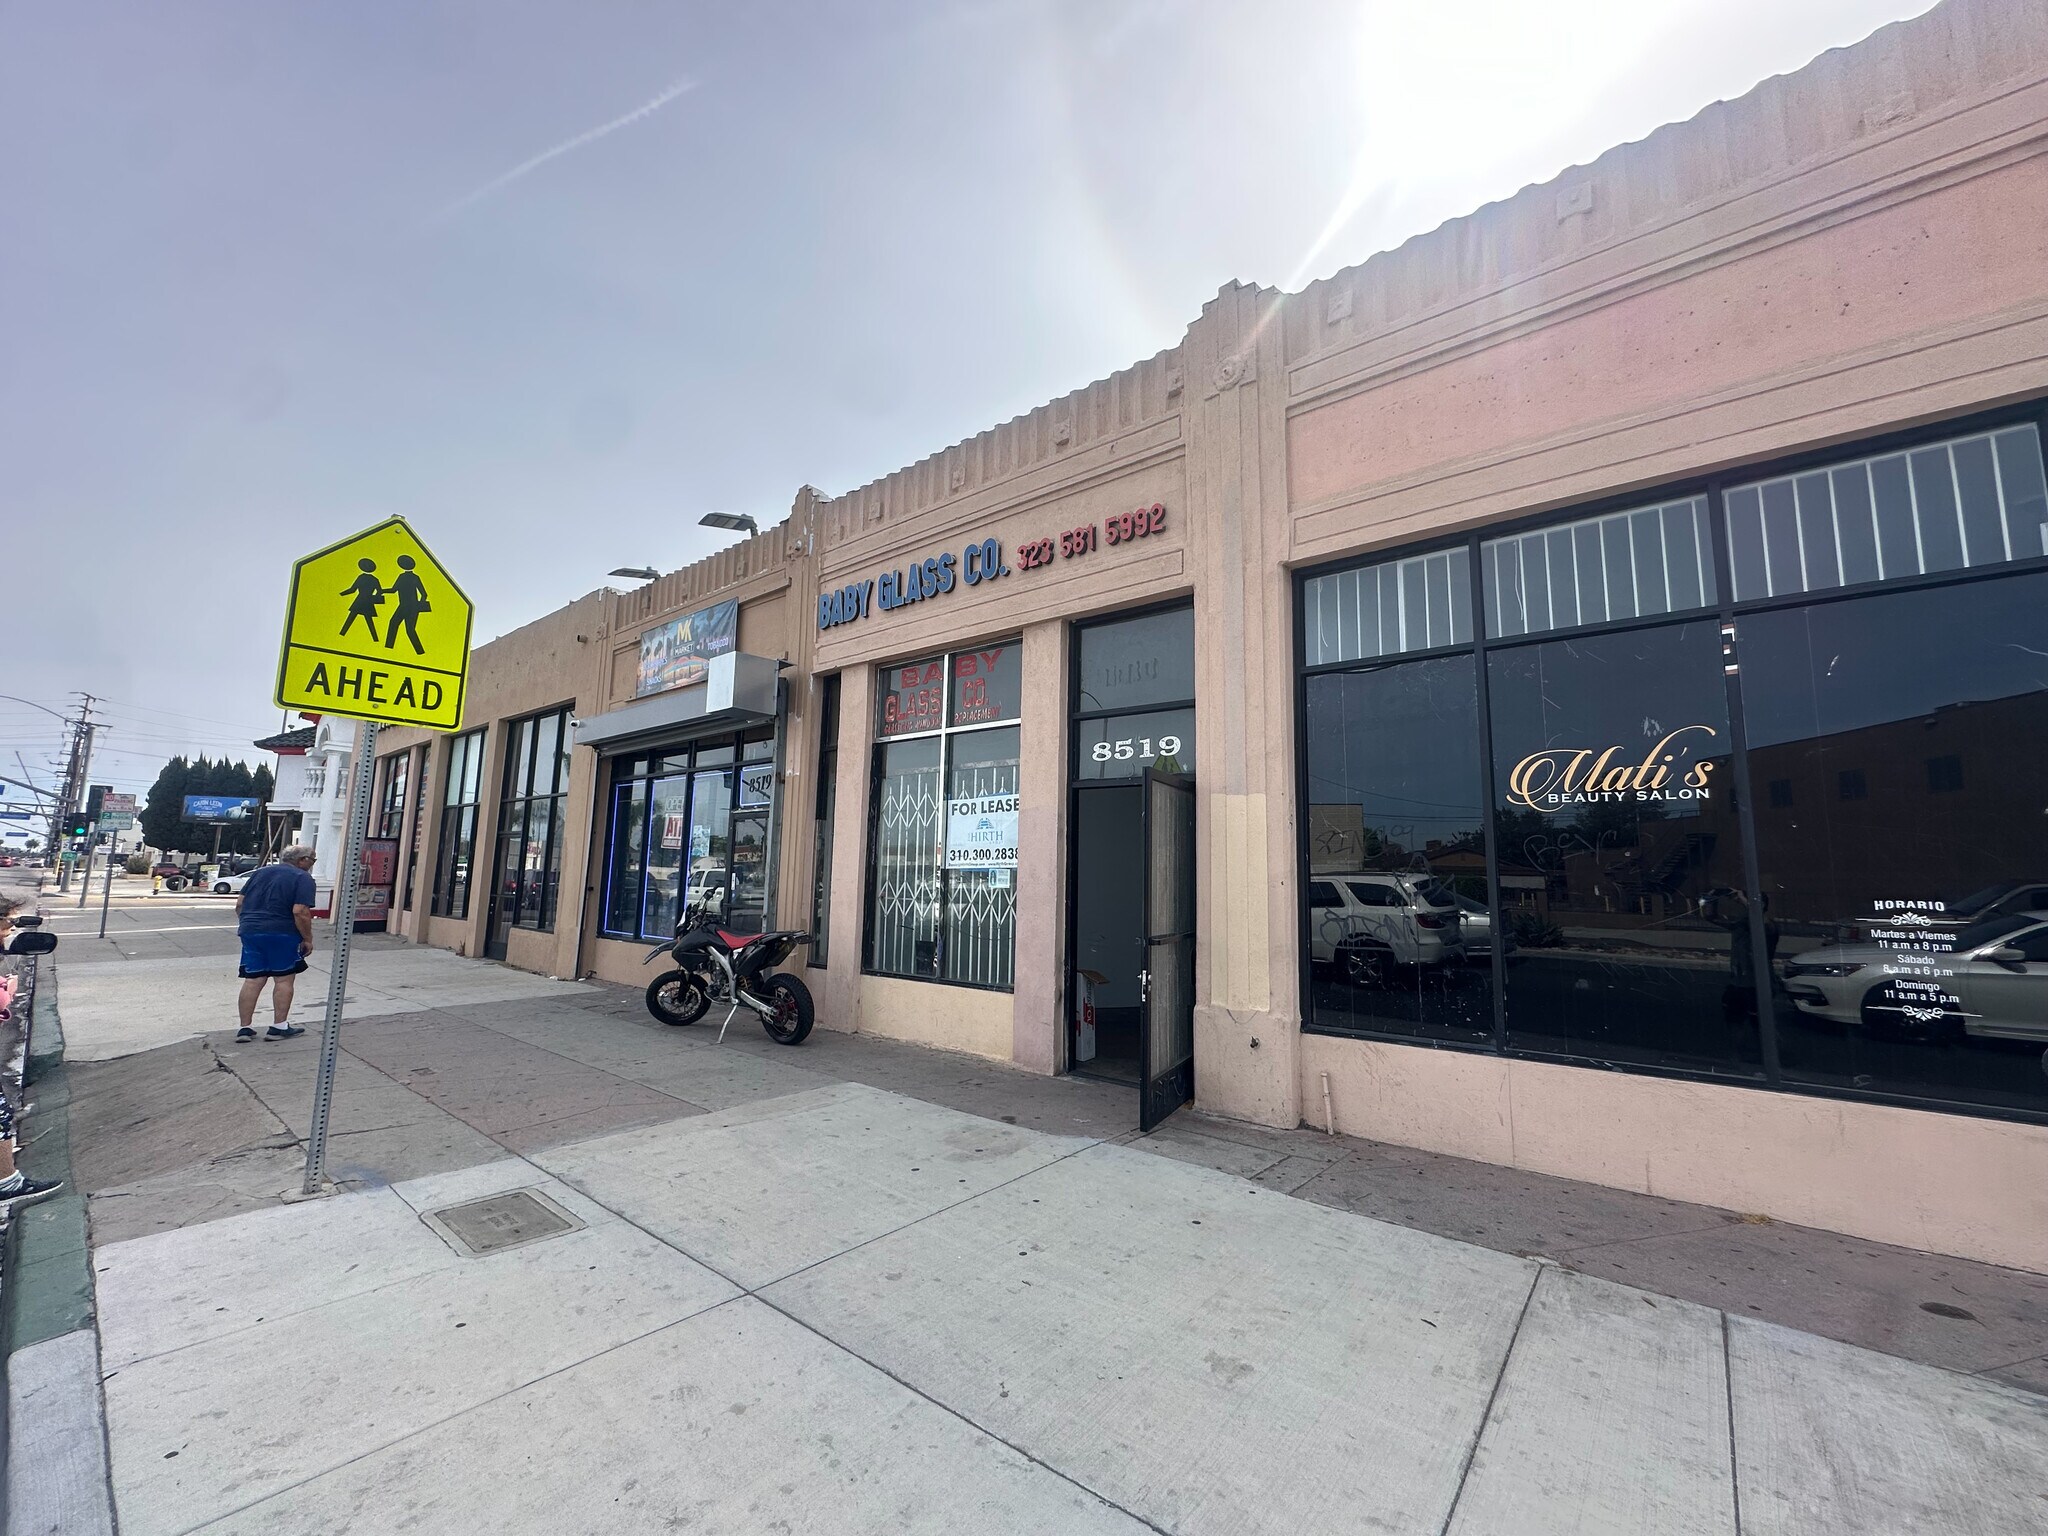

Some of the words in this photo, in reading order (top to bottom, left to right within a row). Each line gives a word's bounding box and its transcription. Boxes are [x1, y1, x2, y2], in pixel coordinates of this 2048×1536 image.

[1016, 537, 1054, 571] 323
[1059, 523, 1098, 558] 581
[1104, 503, 1166, 546] 5992
[818, 579, 873, 630] BABY
[877, 553, 956, 611] GLASS
[963, 537, 1009, 586] CO.
[676, 618, 693, 645] MK
[674, 643, 694, 656] MARKET
[901, 648, 1004, 689] BABY
[304, 662, 443, 710] AHEAD
[884, 687, 942, 723] GLASS
[1091, 735, 1182, 761] 8519
[1506, 725, 1716, 813] Mati's
[748, 773, 772, 793] 8519
[1548, 791, 1625, 803] BEAUTY
[1636, 788, 1710, 801] SALON
[666, 797, 683, 811] OPE
[951, 802, 977, 816] FOR
[981, 798, 1019, 814] LEASE
[665, 817, 682, 838] AT
[970, 830, 1004, 842] HIRTH
[1873, 900, 1945, 911] HORARIO
[1870, 929, 1906, 939] Martes
[1908, 931, 1915, 939] a
[1916, 930, 1957, 941] Viernes
[1878, 940, 1888, 949] 11
[1922, 942, 1930, 950] 8
[1932, 944, 1952, 953] p.m
[1897, 954, 1935, 964] Sábado
[1893, 966, 1911, 974] a.m
[1914, 967, 1921, 975] a
[1923, 966, 1930, 975] 6
[1933, 968, 1953, 977] p.m
[1895, 979, 1940, 992] Domingo
[1884, 990, 1895, 998] 11
[1898, 992, 1917, 1000] a.m
[1929, 992, 1937, 1001] 5
[1940, 994, 1960, 1003] p.m
